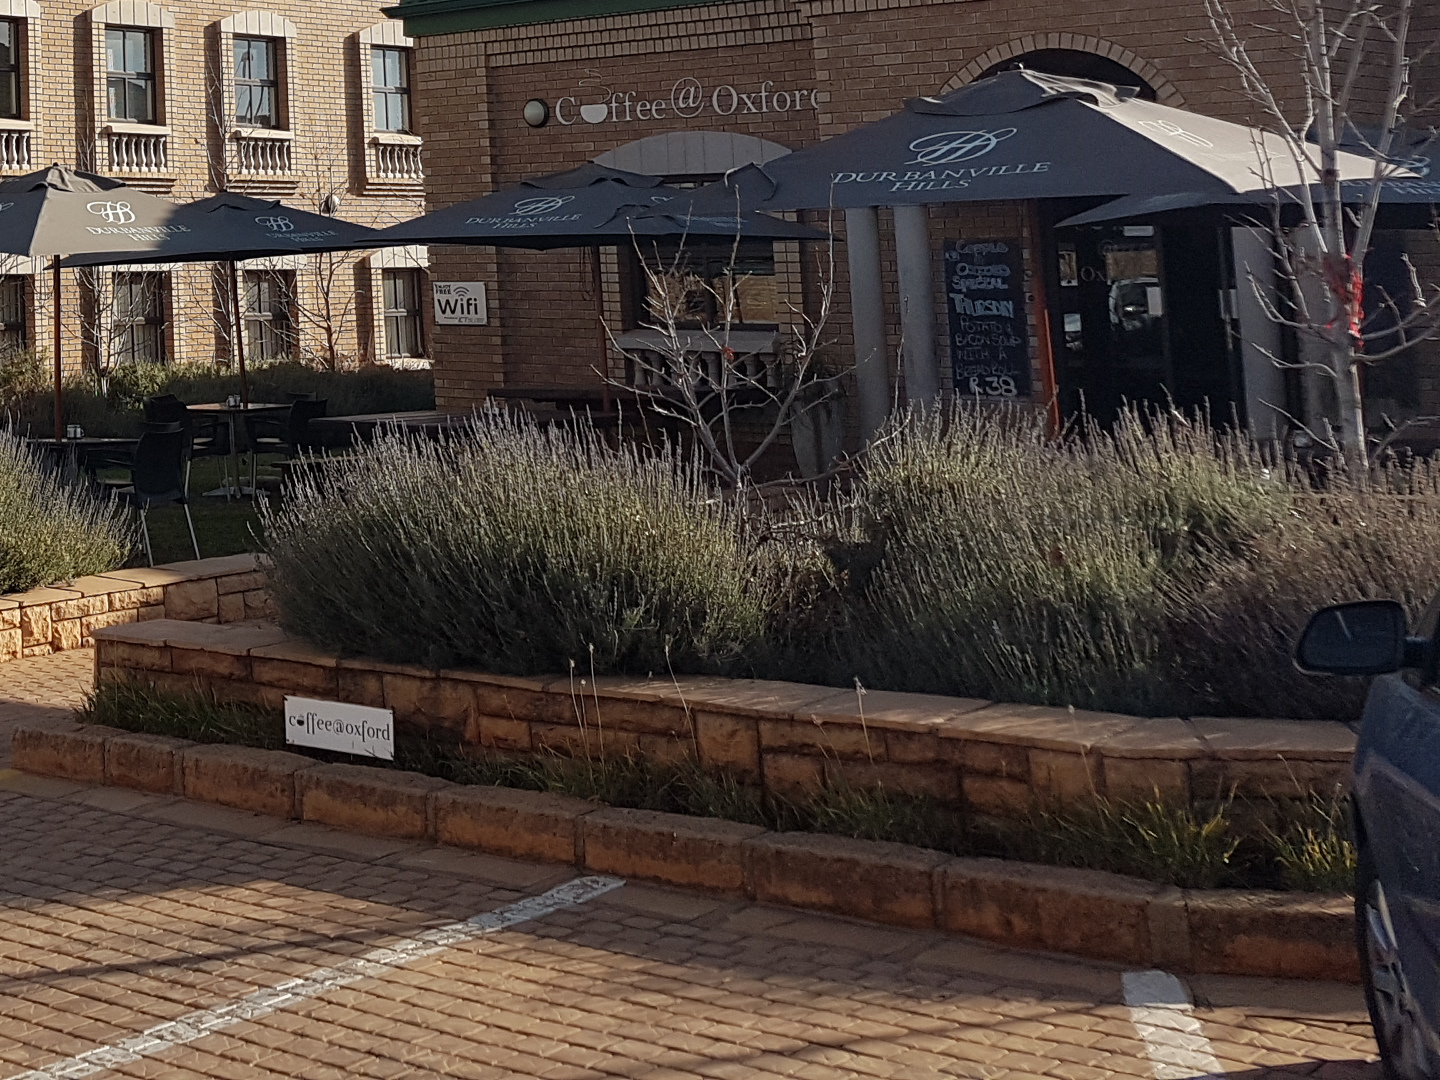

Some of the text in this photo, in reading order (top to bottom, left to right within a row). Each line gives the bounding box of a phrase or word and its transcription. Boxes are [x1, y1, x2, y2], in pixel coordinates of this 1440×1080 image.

[832, 162, 1051, 183] DURBANVILLE
[888, 179, 972, 192] HILLS
[85, 224, 192, 235] DURBANVILLE
[437, 297, 478, 315] Wifi
